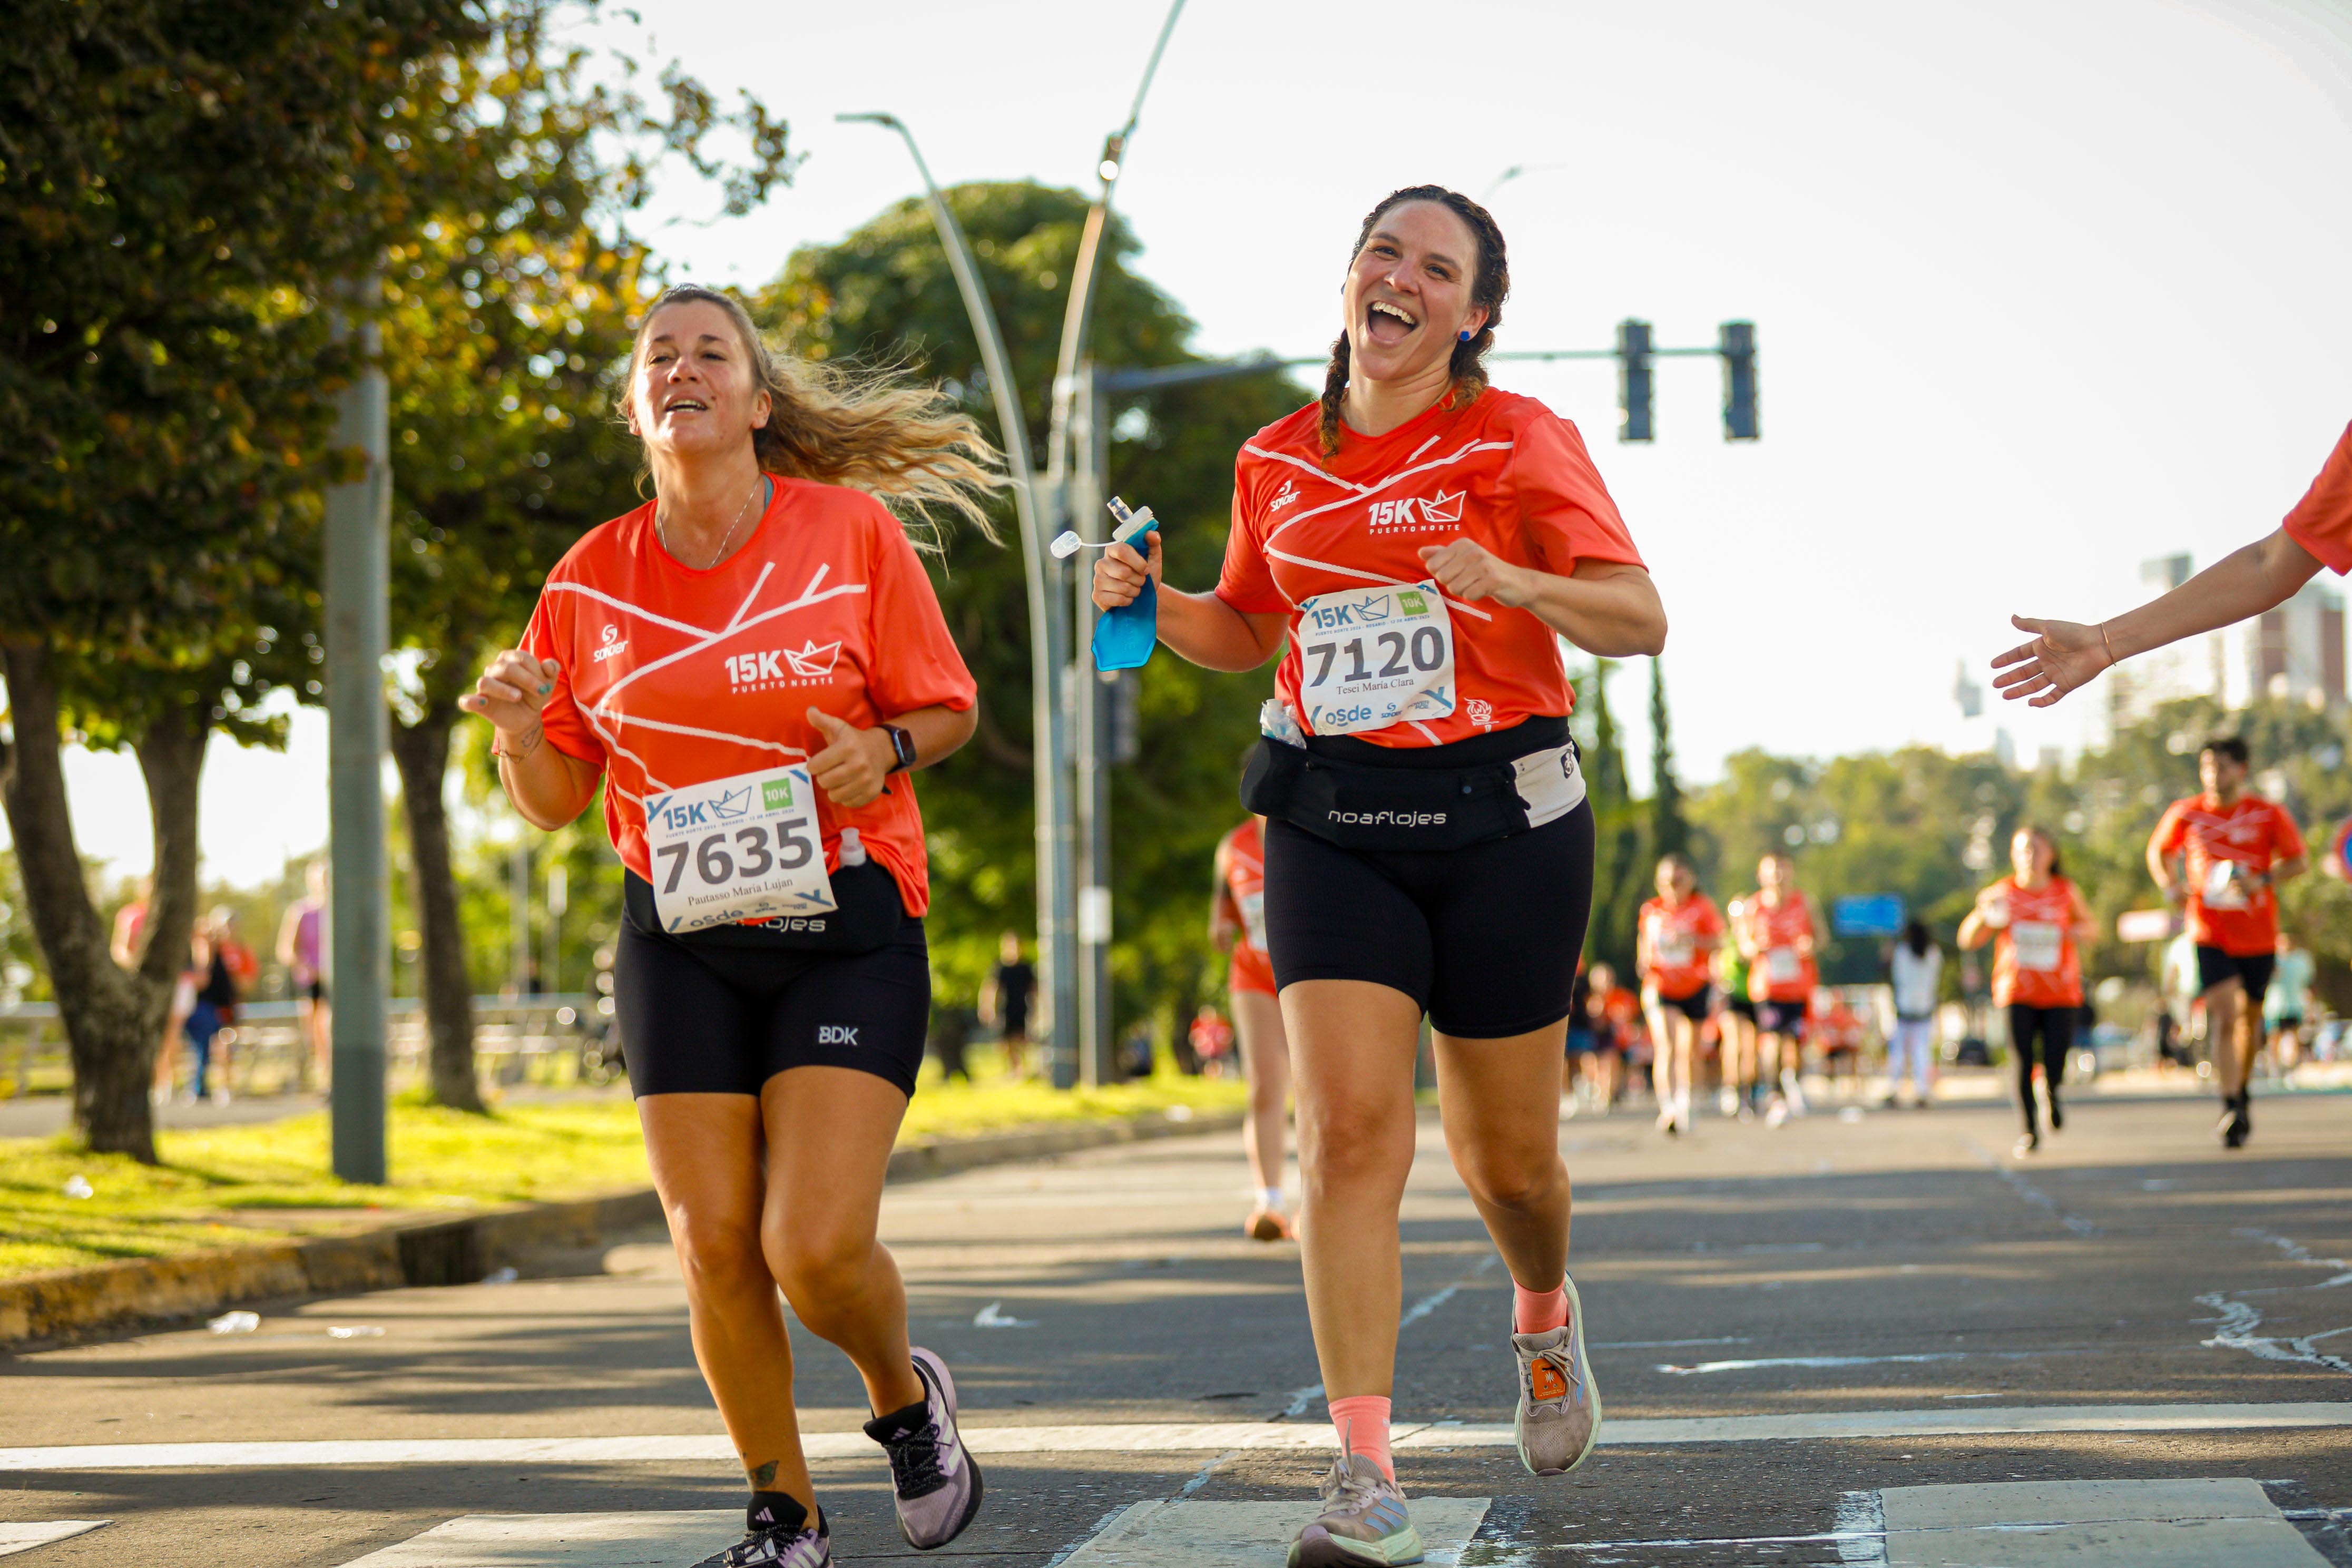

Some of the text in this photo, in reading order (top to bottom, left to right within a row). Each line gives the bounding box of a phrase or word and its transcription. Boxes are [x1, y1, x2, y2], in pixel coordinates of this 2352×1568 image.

[1368, 498, 1416, 526] 15K
[1370, 526, 1416, 535] PUERTO
[1403, 597, 1423, 608] 10K
[1311, 605, 1353, 629] 15K
[725, 650, 784, 684] 15K
[1307, 626, 1445, 688] 7120
[732, 677, 833, 694] PUERTO NORTE
[1336, 683, 1359, 694] Tesei
[1391, 678, 1414, 688] Clara
[1326, 704, 1372, 727] osde
[766, 787, 789, 801] 10K
[663, 801, 707, 830] 15K
[1328, 810, 1447, 827] noaflojes
[657, 818, 813, 895] 7635
[688, 891, 730, 906] Pautasso
[764, 879, 793, 891] Lujan
[818, 1025, 858, 1045] BDK
